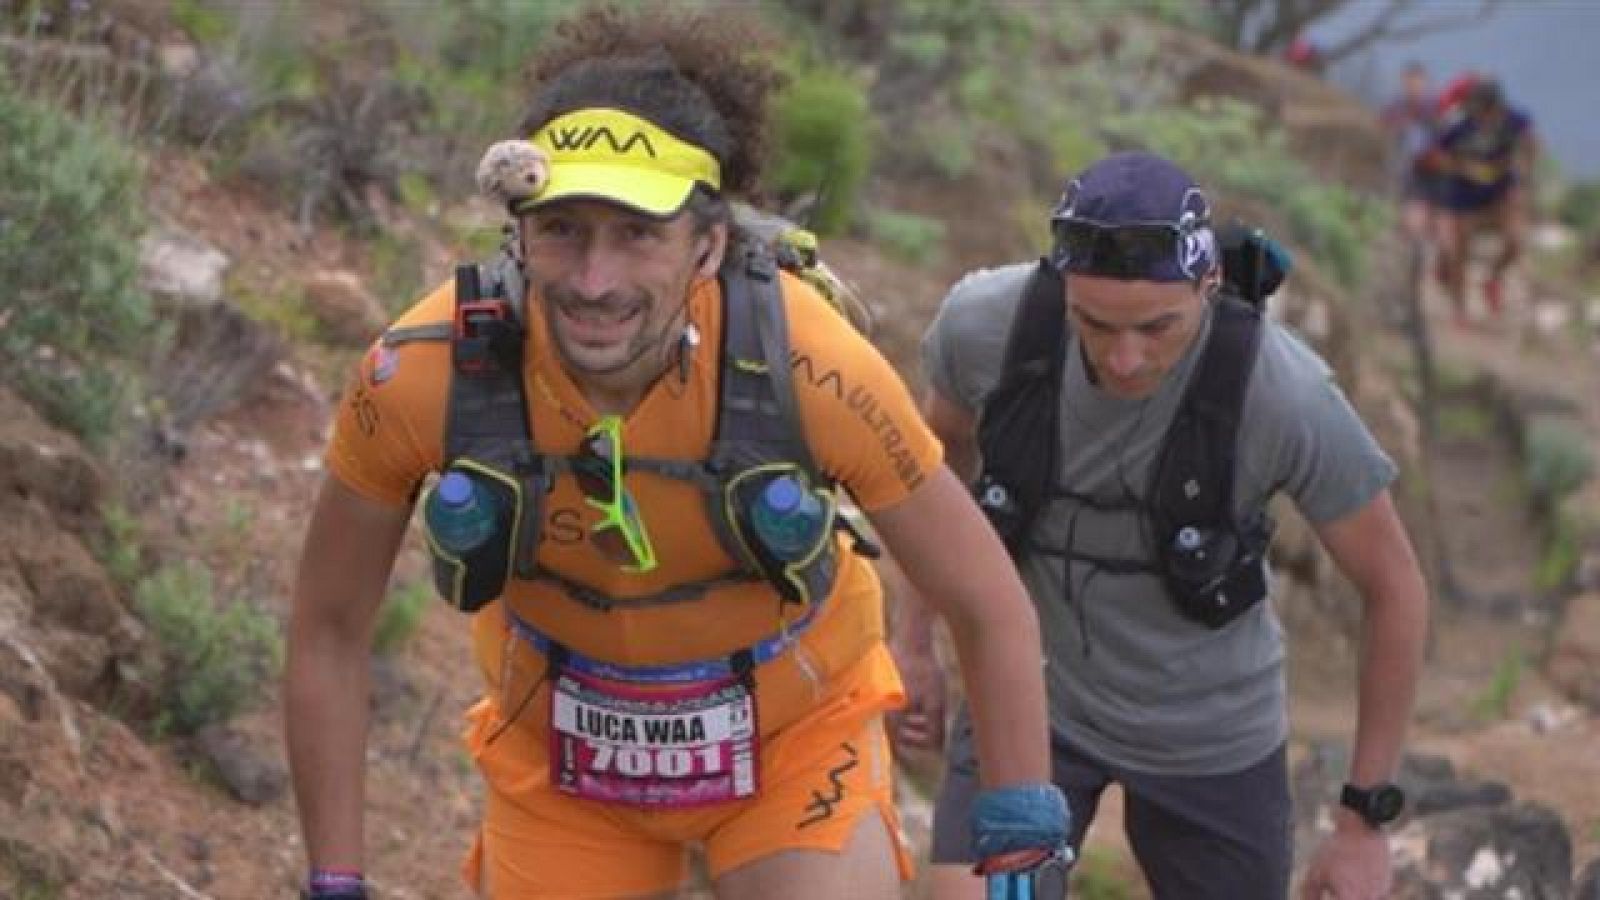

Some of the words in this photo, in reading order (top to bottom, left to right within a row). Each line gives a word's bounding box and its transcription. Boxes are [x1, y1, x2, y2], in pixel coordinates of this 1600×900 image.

[548, 126, 656, 159] WAA
[575, 704, 638, 742] LUCA
[643, 716, 706, 744] WAA
[590, 742, 721, 776] 7001
